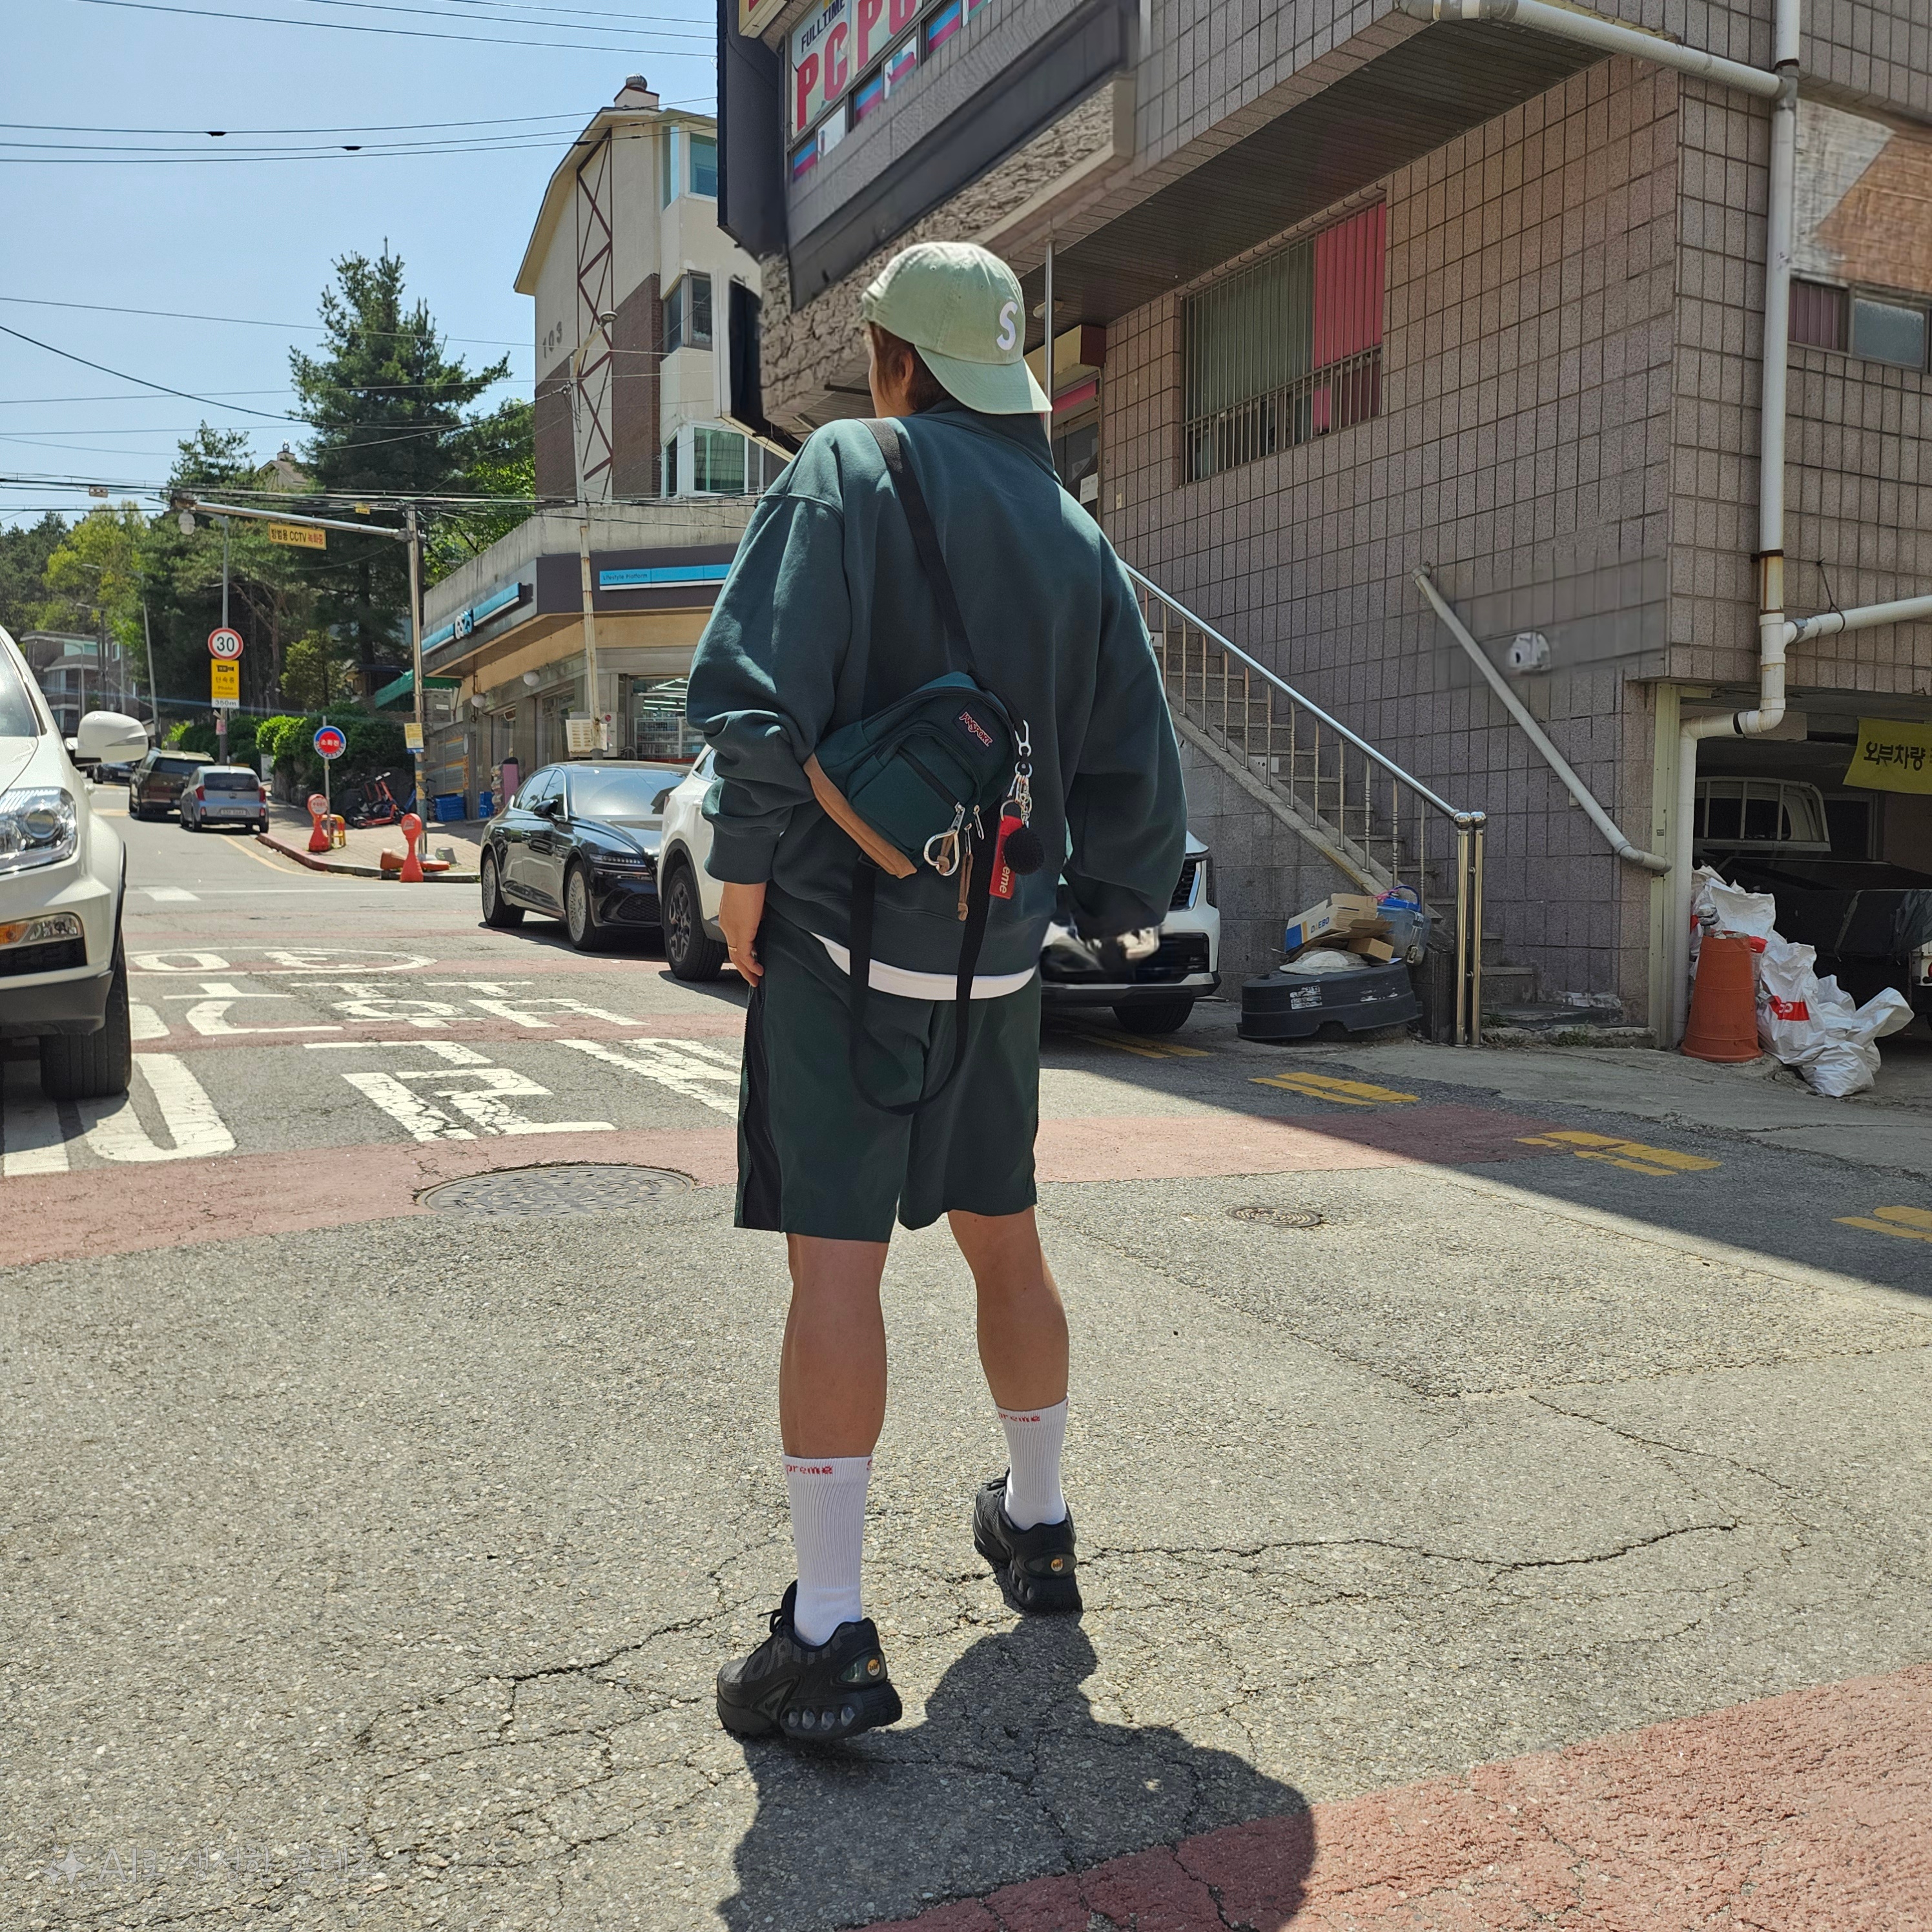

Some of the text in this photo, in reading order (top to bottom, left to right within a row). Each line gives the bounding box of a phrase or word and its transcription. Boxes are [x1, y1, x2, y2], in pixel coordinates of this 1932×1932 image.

[797, 22, 848, 132] PC
[542, 321, 562, 359] 103
[996, 301, 1018, 351] S
[271, 528, 288, 540] 방범용
[290, 531, 307, 542] CCTV
[216, 636, 234, 652] 30
[958, 712, 993, 747] JANSPORT
[999, 865, 1011, 894] eme
